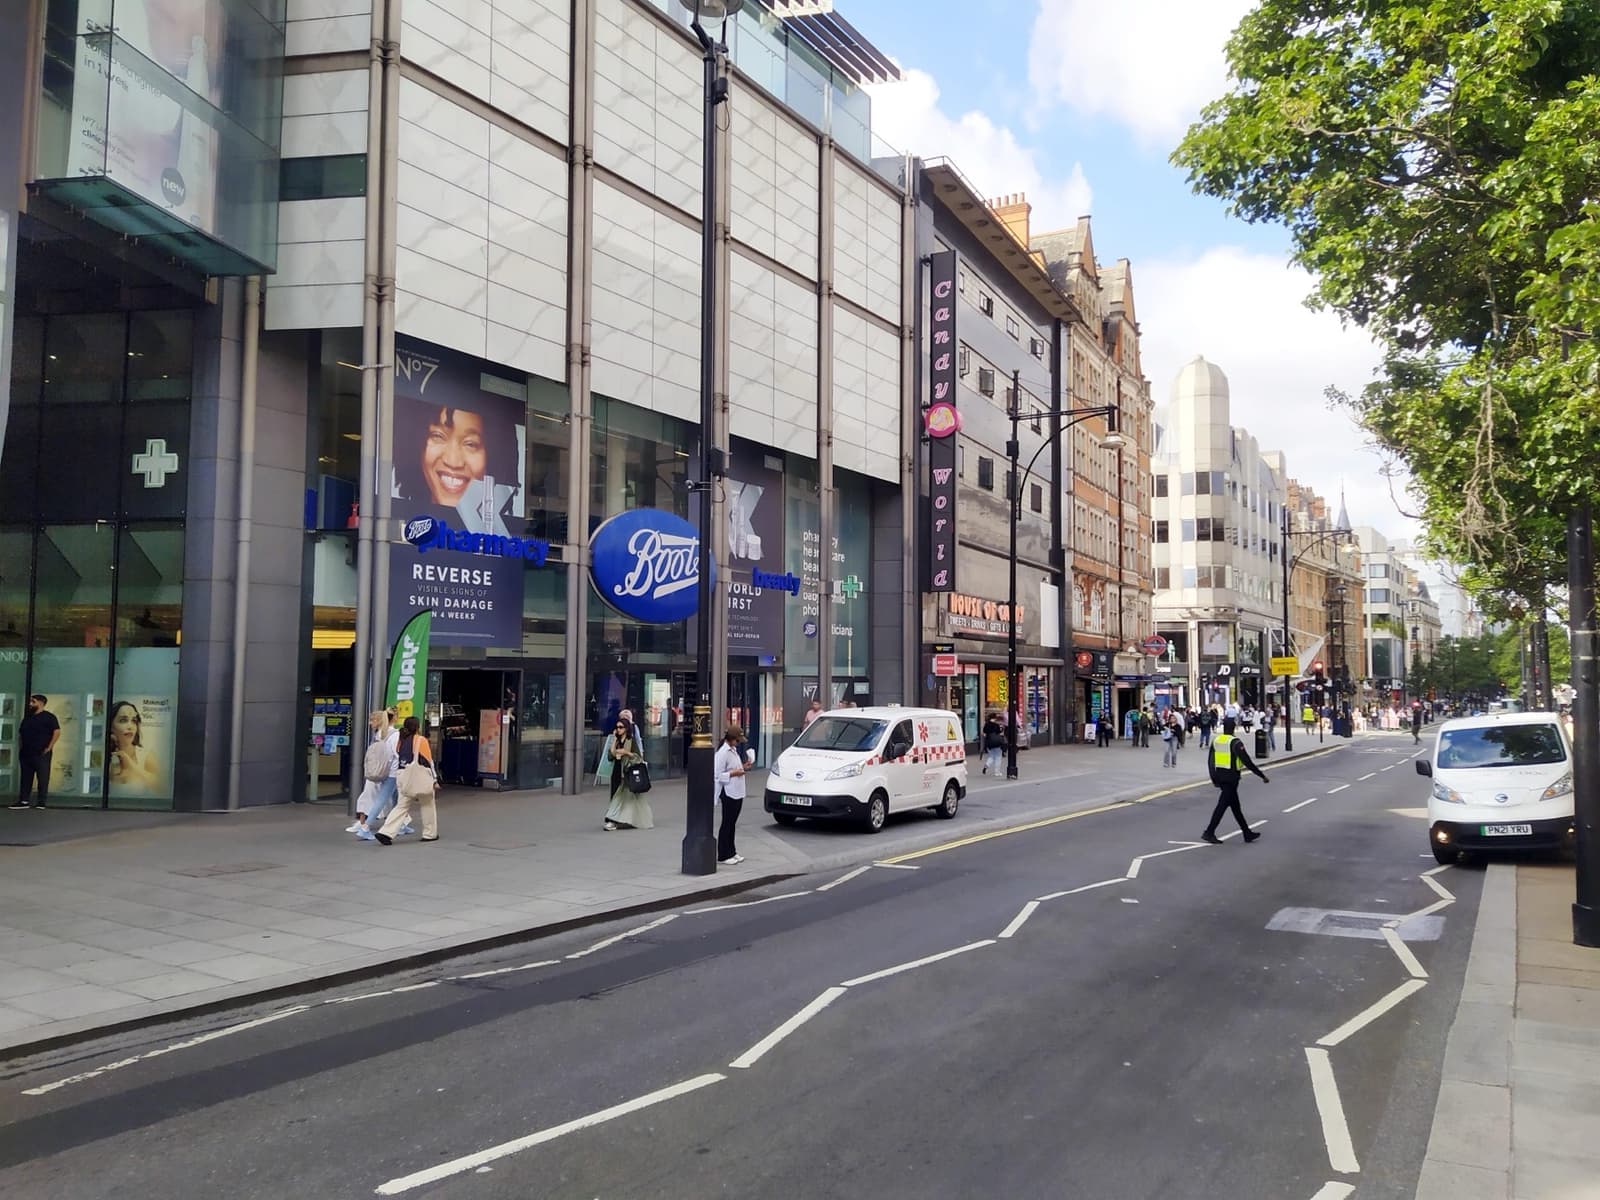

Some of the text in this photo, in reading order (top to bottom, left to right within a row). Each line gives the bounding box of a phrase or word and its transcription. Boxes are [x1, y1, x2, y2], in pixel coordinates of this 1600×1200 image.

[163, 178, 185, 198] new
[933, 279, 952, 588] Candy World
[412, 563, 493, 586] REVERSE
[417, 584, 487, 597] VISIBLE SIGNS OF
[409, 595, 494, 611] SKIN DAMAGE
[728, 596, 753, 611] IRST
[950, 592, 982, 618] HOUSE
[983, 600, 998, 620] OF
[440, 611, 445, 619] 4
[447, 611, 476, 620] WEEKS
[1217, 664, 1232, 676] JD
[1488, 824, 1529, 834] PN21 YRU
